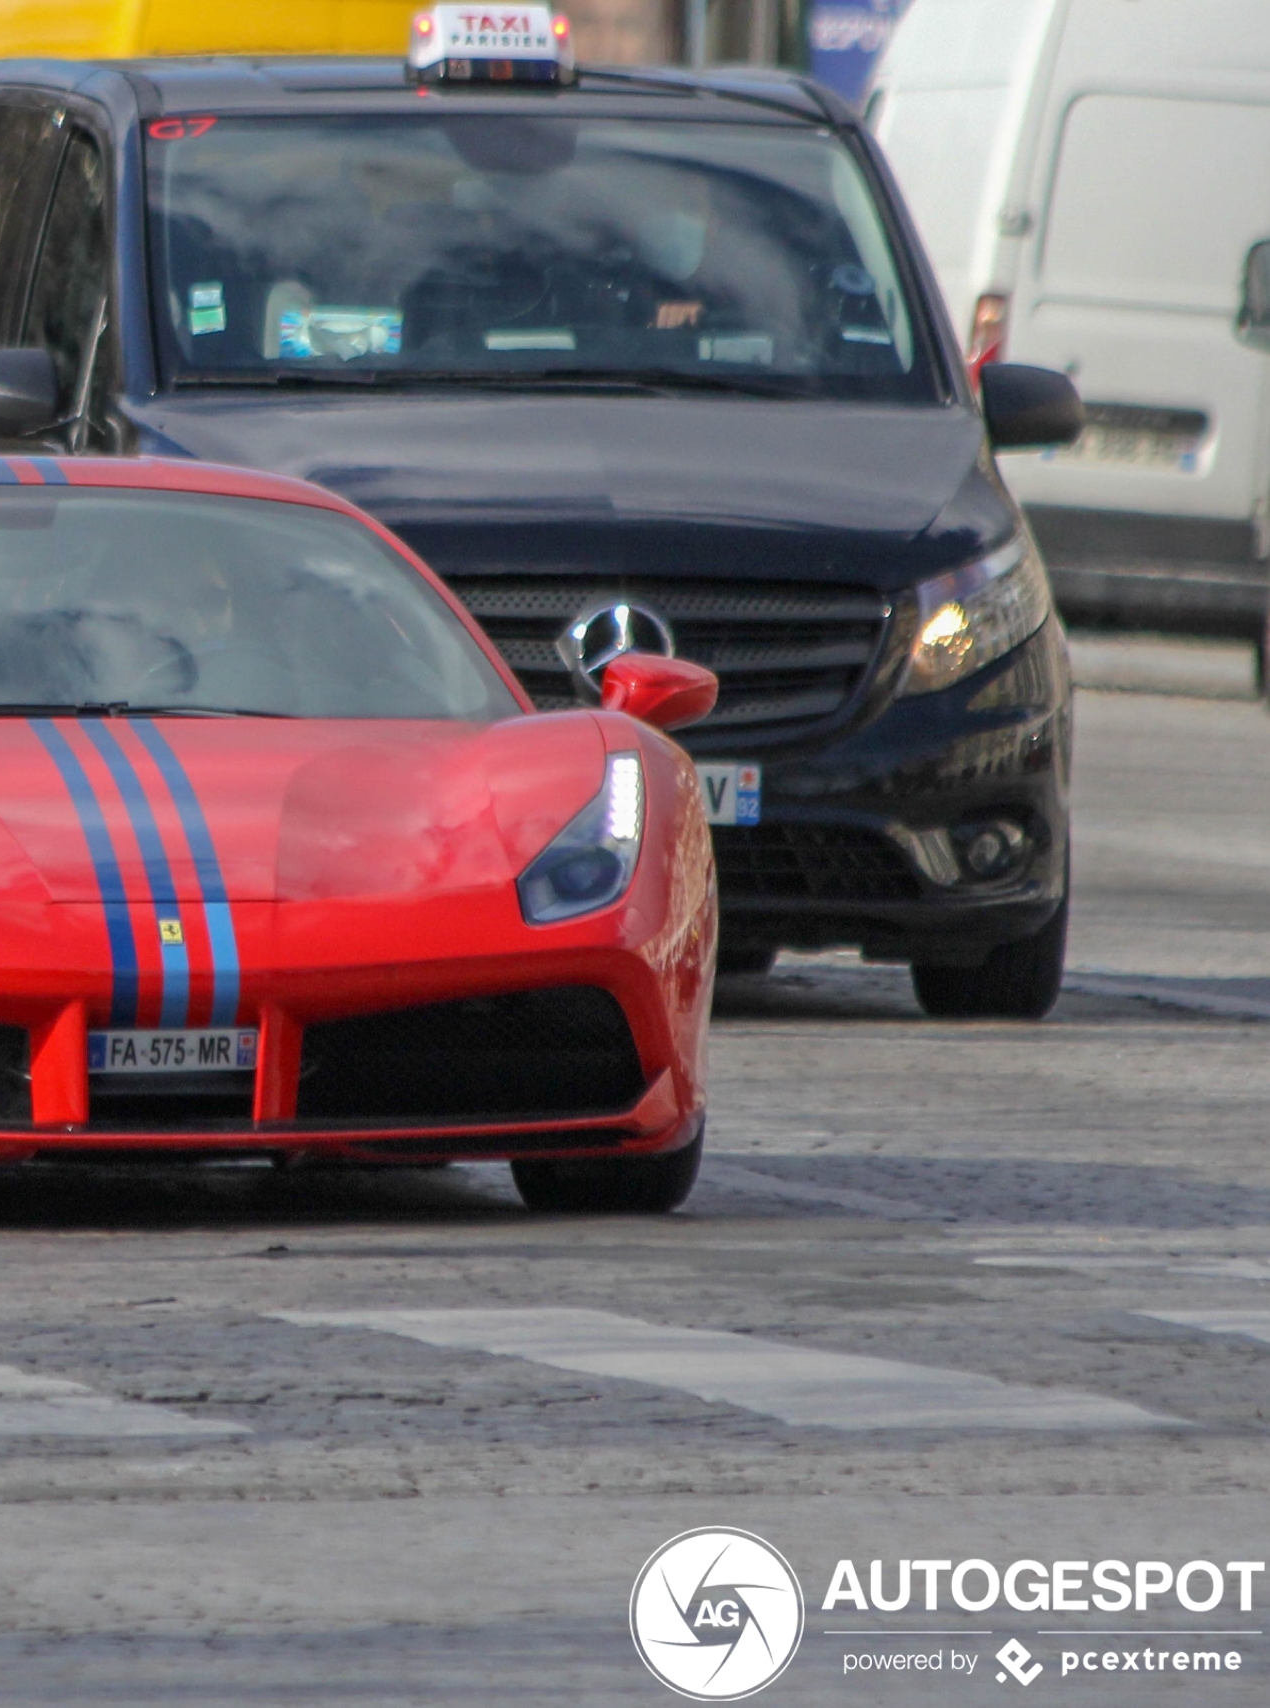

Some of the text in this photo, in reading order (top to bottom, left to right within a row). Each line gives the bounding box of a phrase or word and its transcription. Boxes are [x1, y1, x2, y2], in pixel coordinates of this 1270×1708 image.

[459, 16, 530, 32] TAXI
[451, 35, 546, 47] PARISIEN
[148, 117, 218, 139] G7
[737, 798, 758, 817] 92
